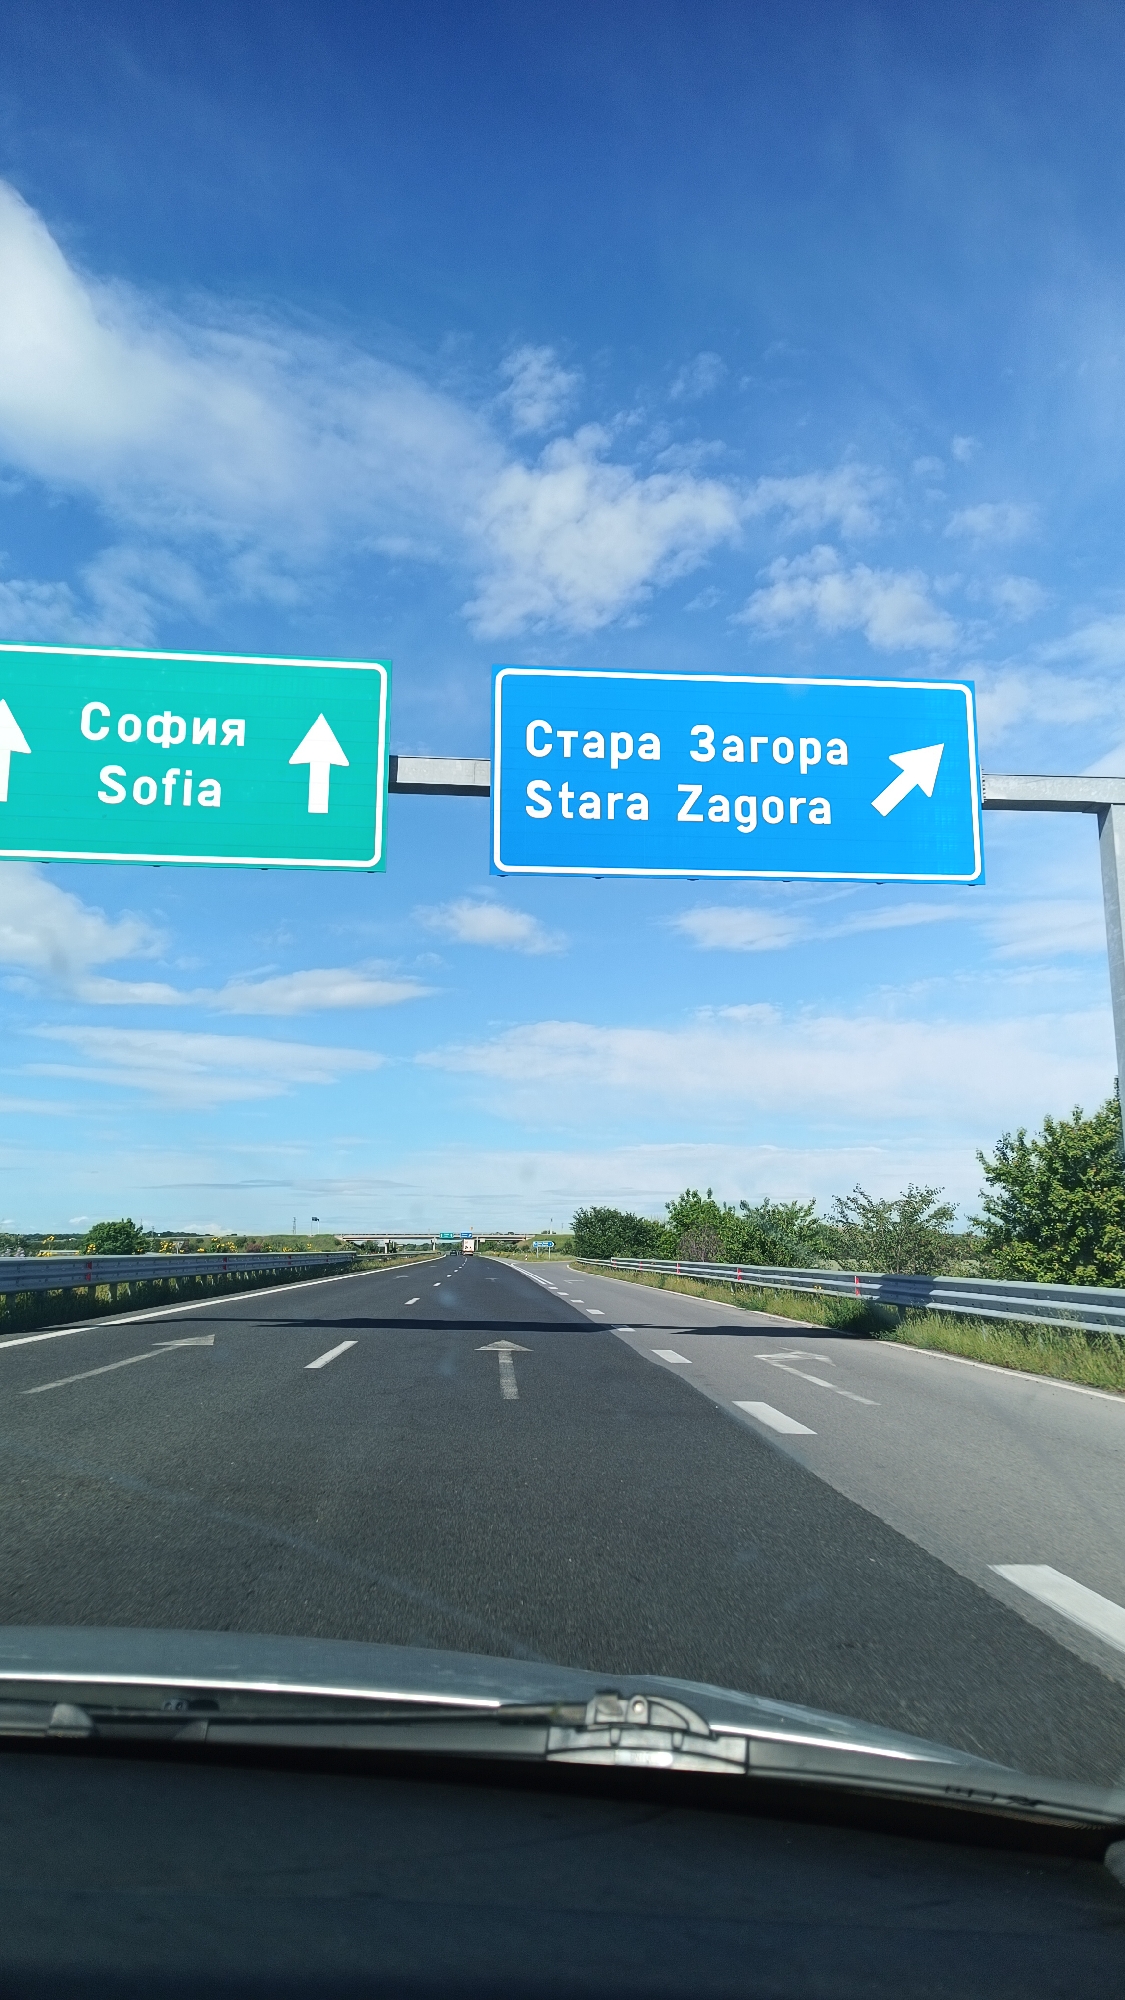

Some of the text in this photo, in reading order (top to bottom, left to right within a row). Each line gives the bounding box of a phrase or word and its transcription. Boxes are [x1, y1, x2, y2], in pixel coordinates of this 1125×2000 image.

[80, 701, 246, 749] София
[525, 719, 849, 775] Стара Загора
[97, 764, 222, 808] Sofia
[525, 779, 832, 834] Stara Zagora
